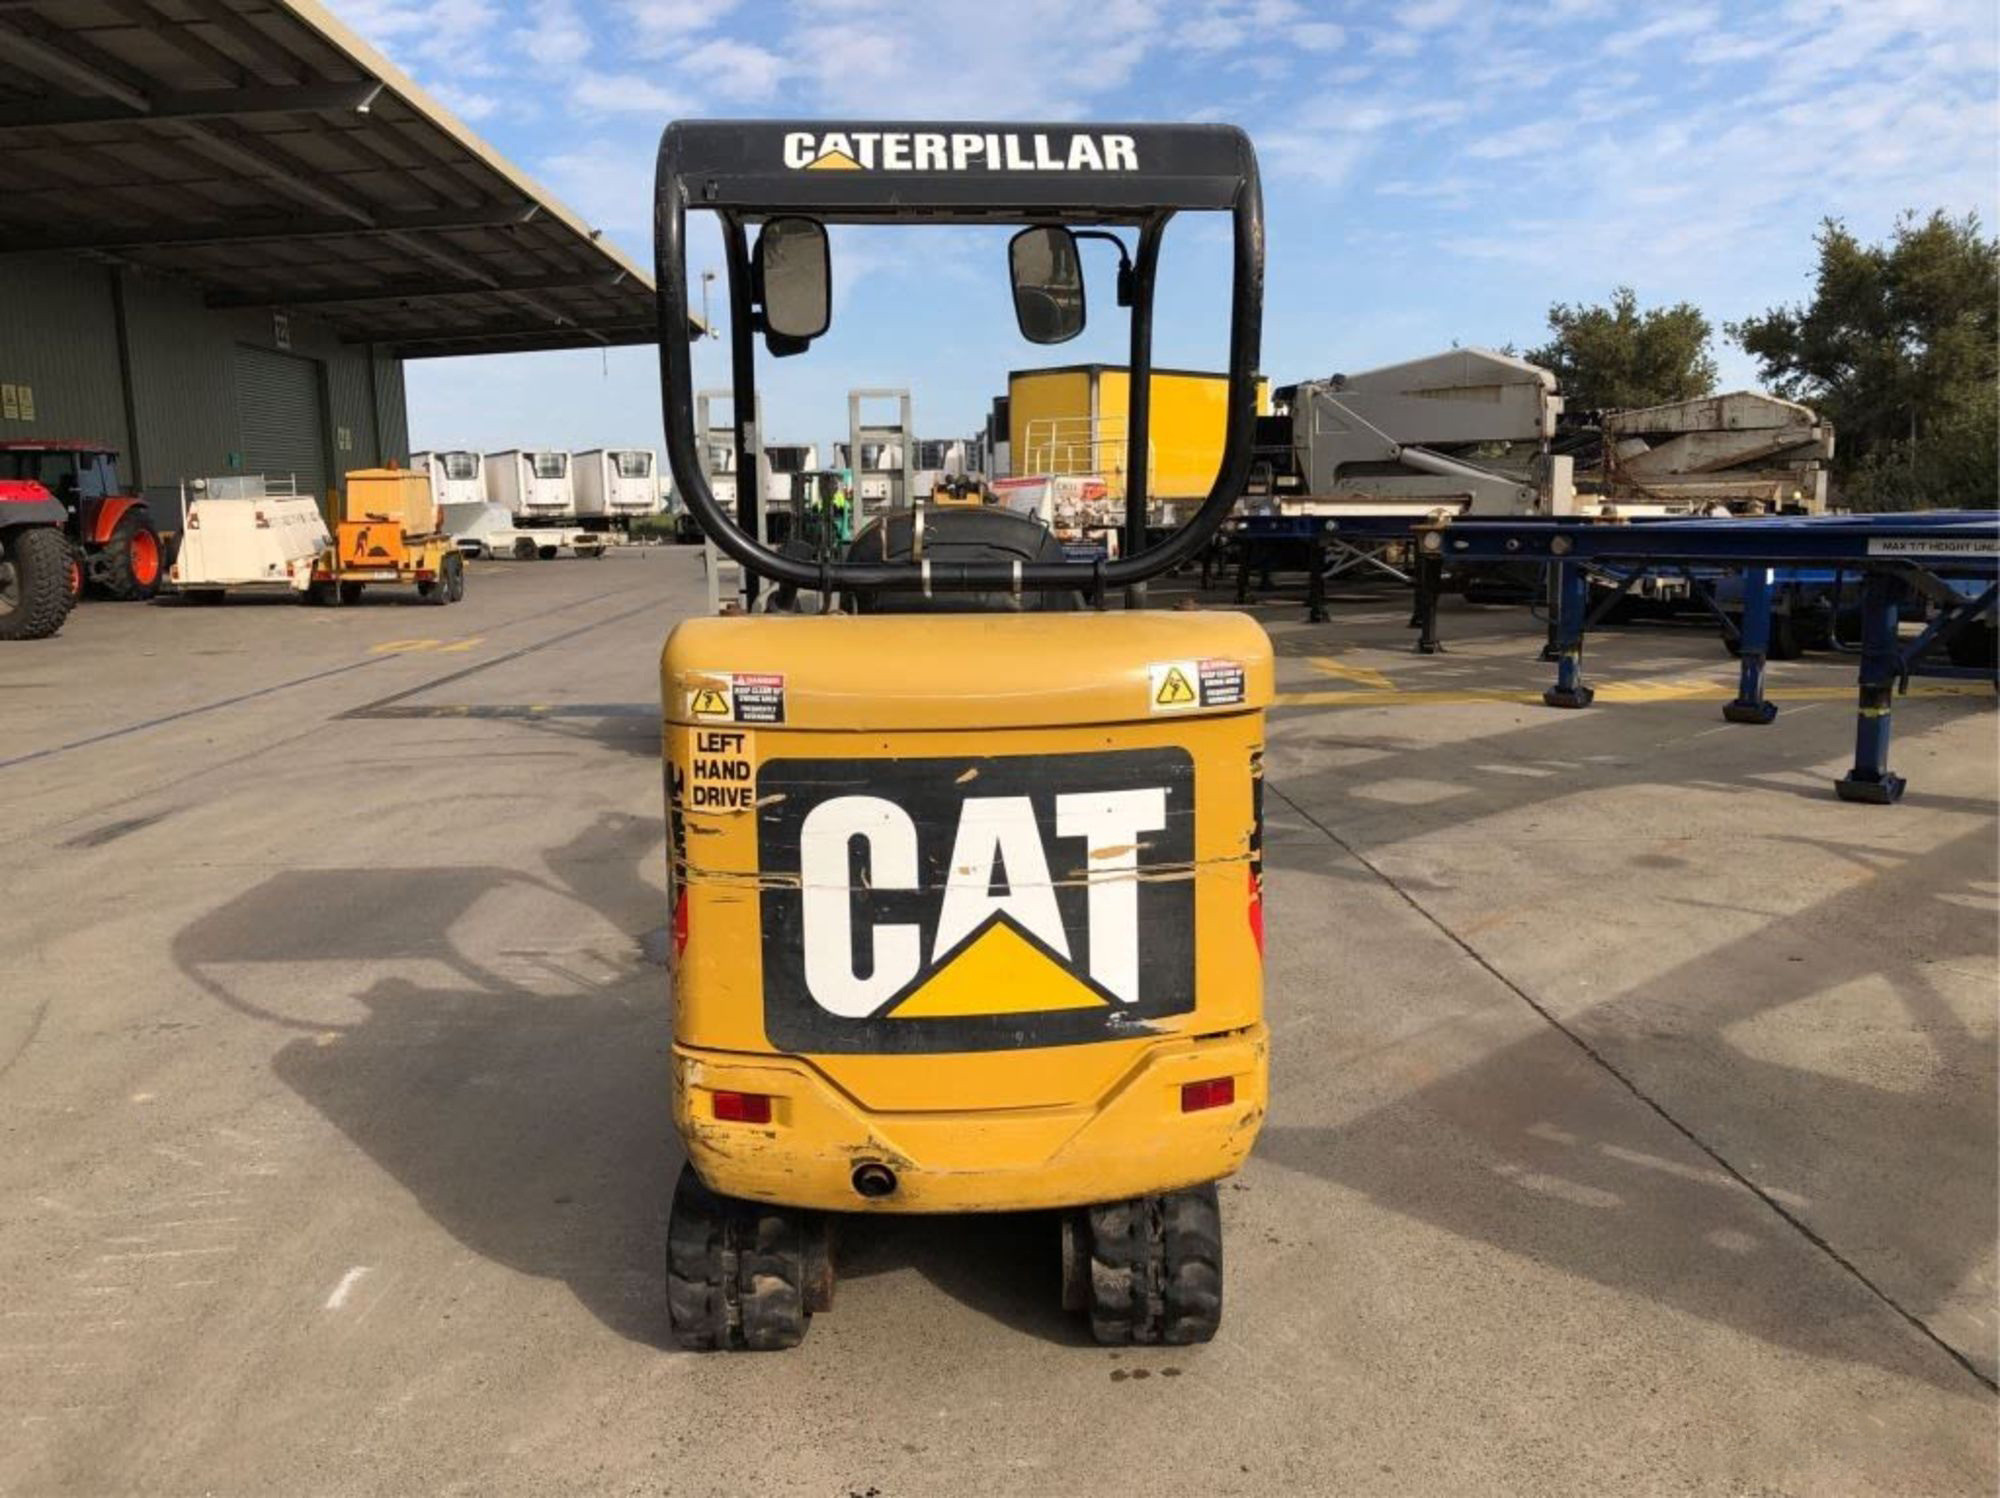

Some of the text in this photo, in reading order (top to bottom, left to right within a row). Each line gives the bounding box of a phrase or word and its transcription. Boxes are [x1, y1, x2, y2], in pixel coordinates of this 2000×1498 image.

[783, 132, 1139, 170] CATERPILLAR
[1882, 541, 1906, 552] MAX
[696, 733, 745, 753] LEFT
[694, 759, 751, 780] HAND
[693, 786, 753, 807] DRIVE
[800, 787, 1166, 1018] CAT
